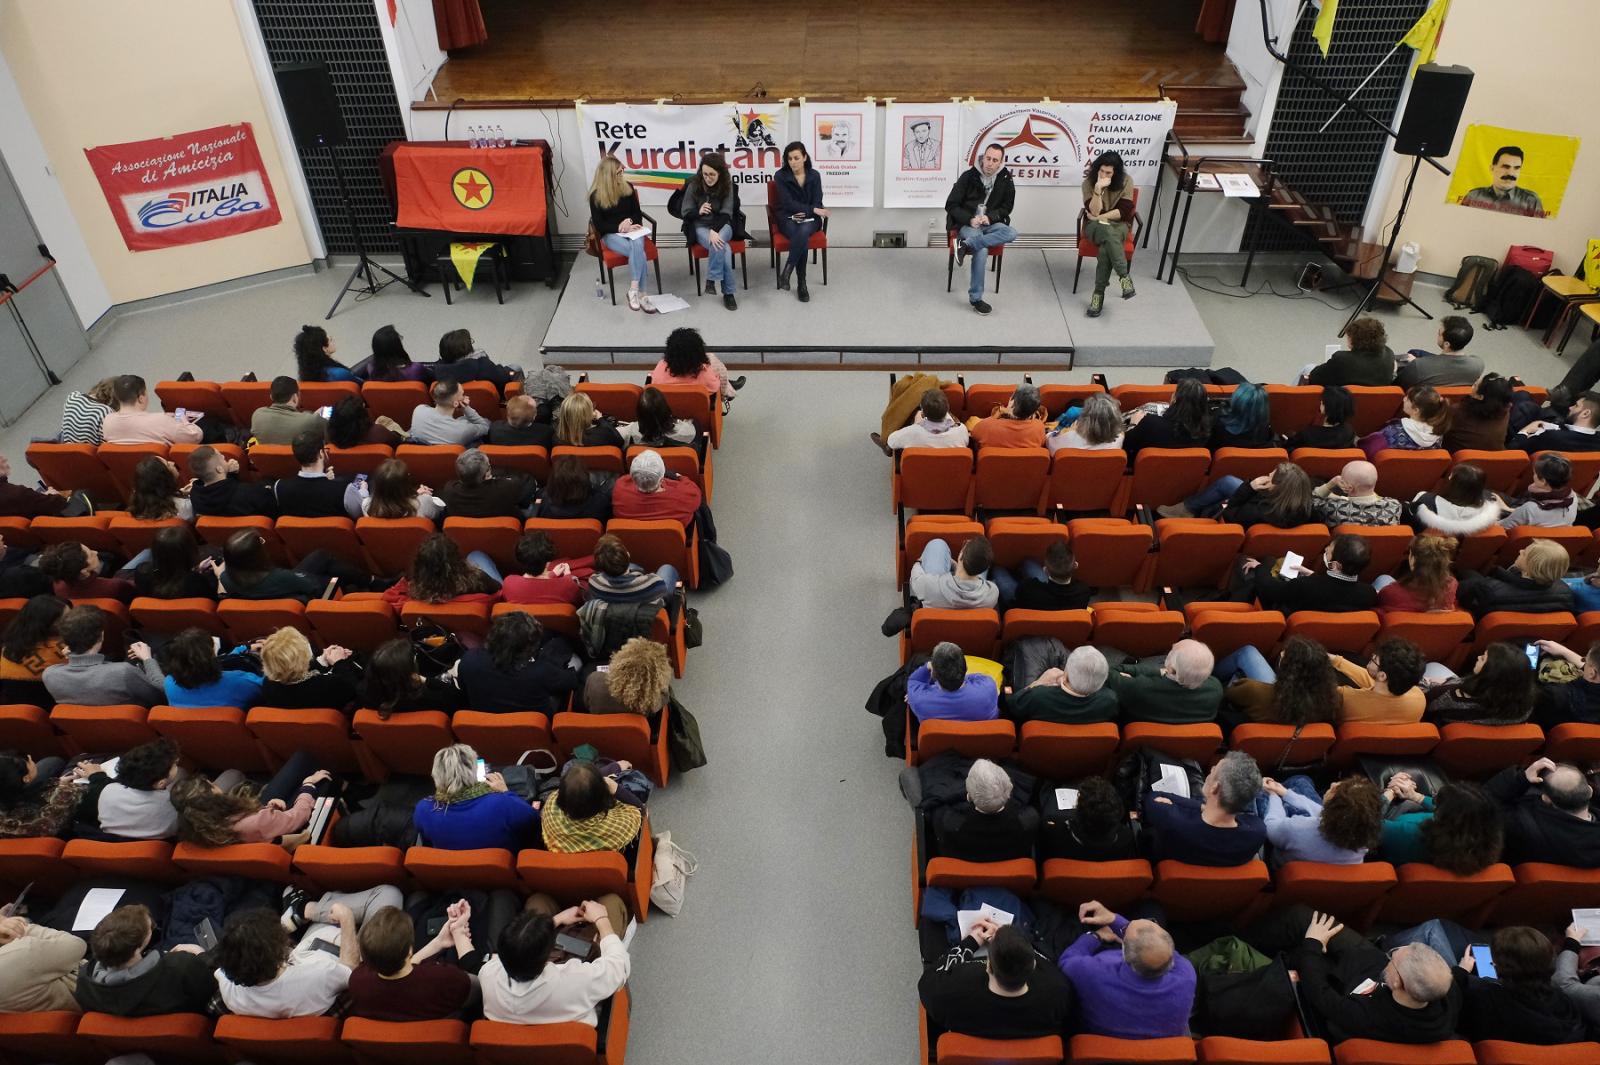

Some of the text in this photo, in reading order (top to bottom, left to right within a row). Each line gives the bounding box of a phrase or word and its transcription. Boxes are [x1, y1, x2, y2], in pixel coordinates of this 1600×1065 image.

[1091, 112, 1163, 122] ASSOCIAZIONE
[595, 121, 647, 139] Rete
[1089, 123, 1133, 133] ITALIANA
[1088, 135, 1151, 145] COMBATTENTI
[111, 130, 247, 175] Associazione Nazionale
[141, 151, 234, 184] di Amicizia
[191, 182, 249, 207] ITALIA
[141, 198, 264, 228] Cuba
